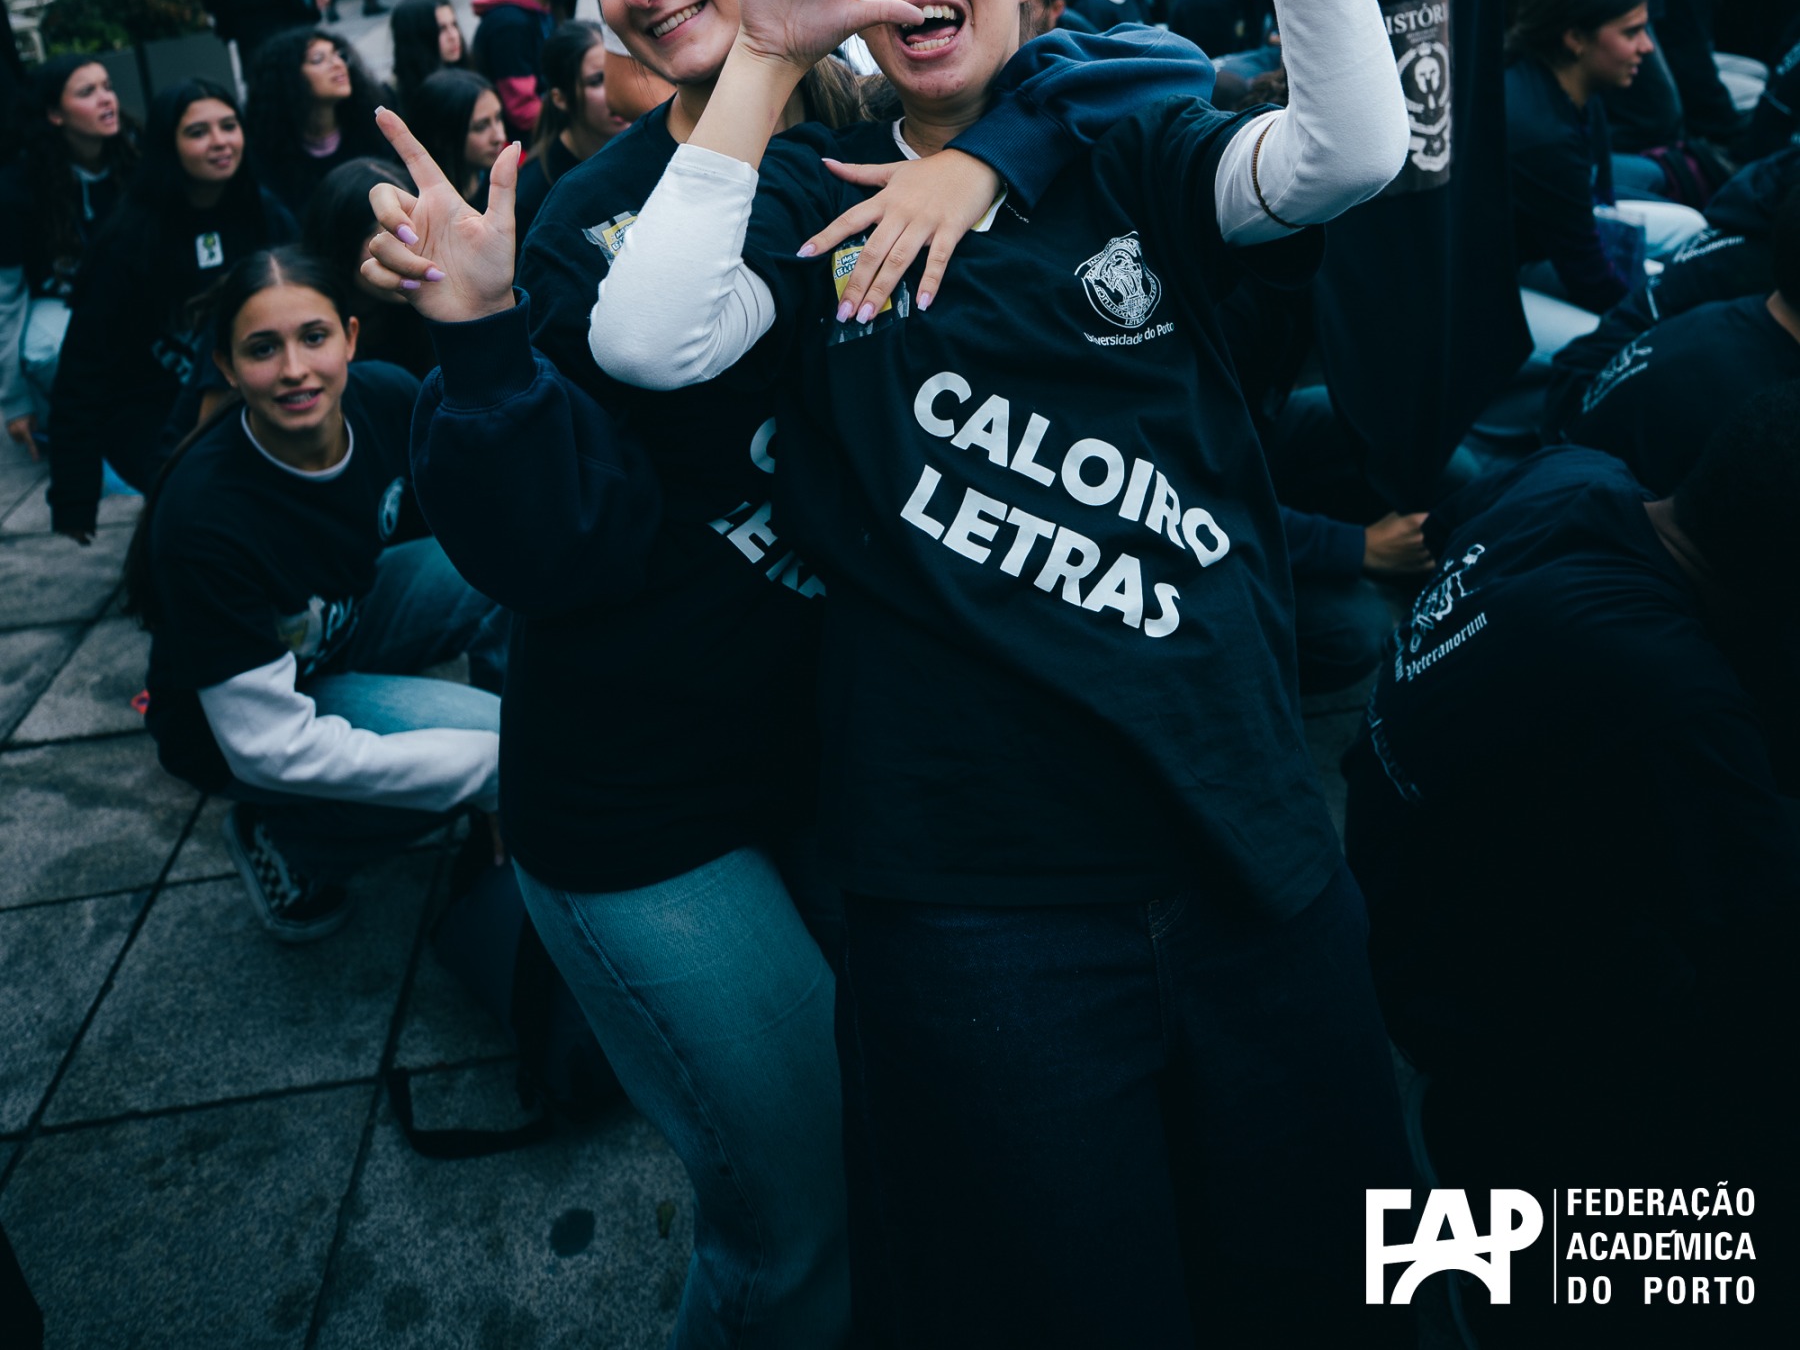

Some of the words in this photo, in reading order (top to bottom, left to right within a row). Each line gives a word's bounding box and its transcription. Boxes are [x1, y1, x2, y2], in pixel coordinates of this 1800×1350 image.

[1144, 327, 1156, 340] do
[914, 371, 1230, 568] CALOIRO
[900, 465, 1181, 638] LETRAS
[1406, 612, 1488, 683] Veteranorum
